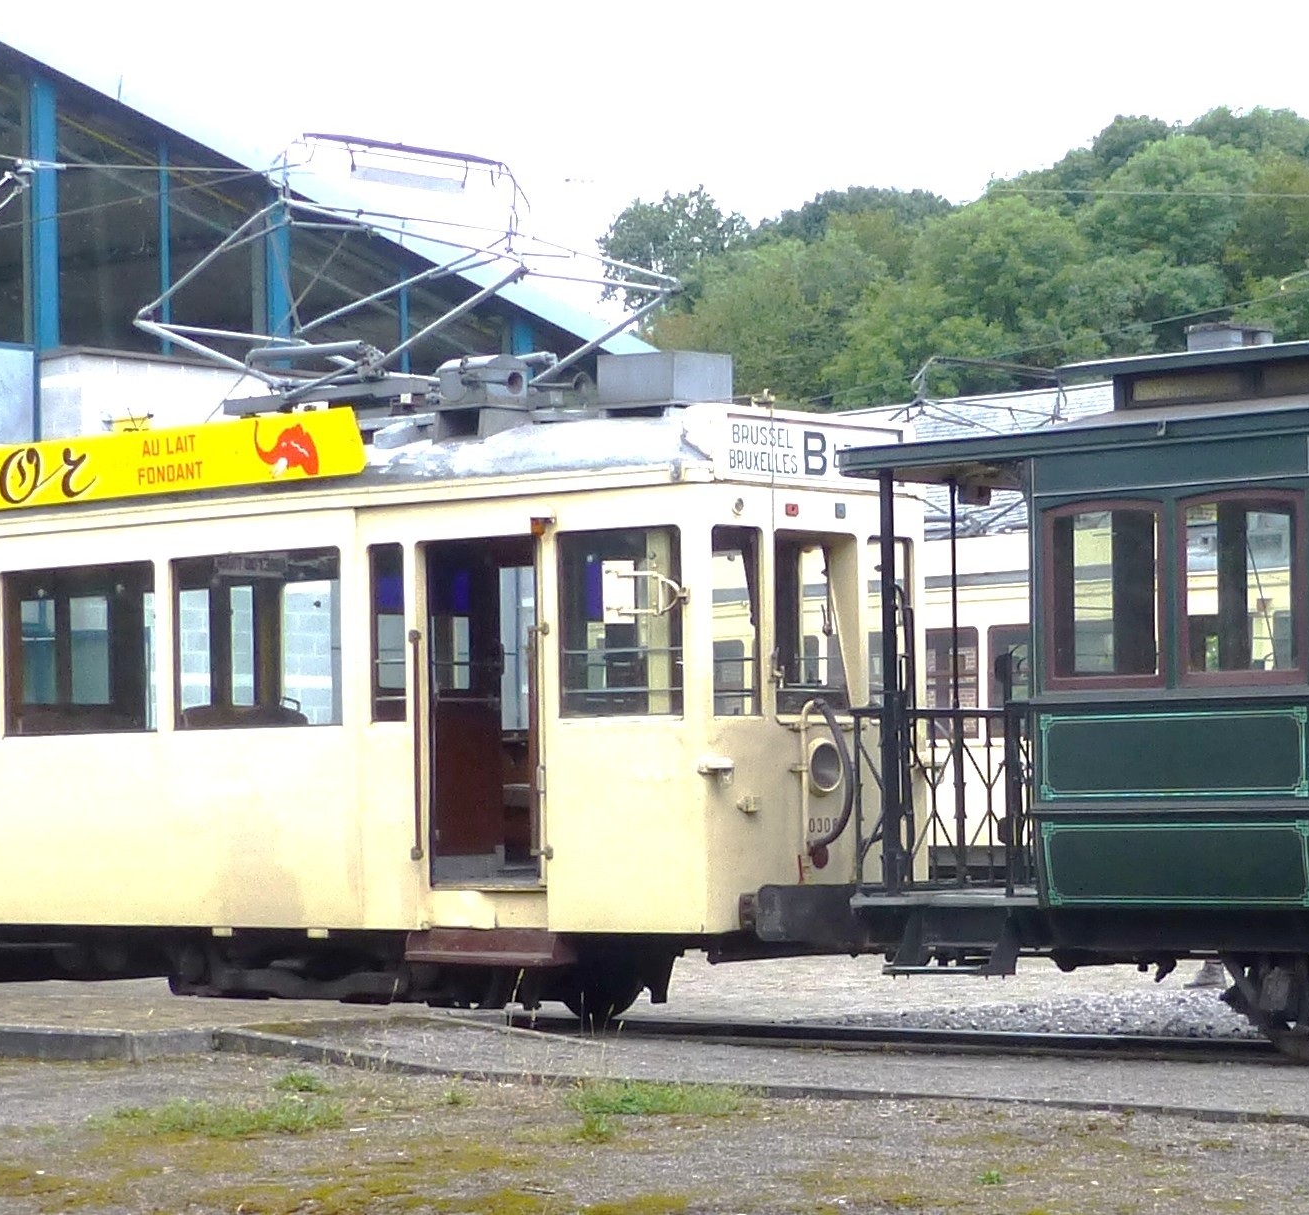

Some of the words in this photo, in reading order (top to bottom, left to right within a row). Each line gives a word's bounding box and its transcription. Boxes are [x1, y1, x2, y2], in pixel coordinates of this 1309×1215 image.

[142, 440, 160, 458] AU
[166, 434, 196, 454] LAIT
[732, 424, 793, 448] BRUSSEL
[729, 449, 798, 474] BRUXELLES
[803, 430, 827, 476] B
[137, 460, 203, 486] FONDANT
